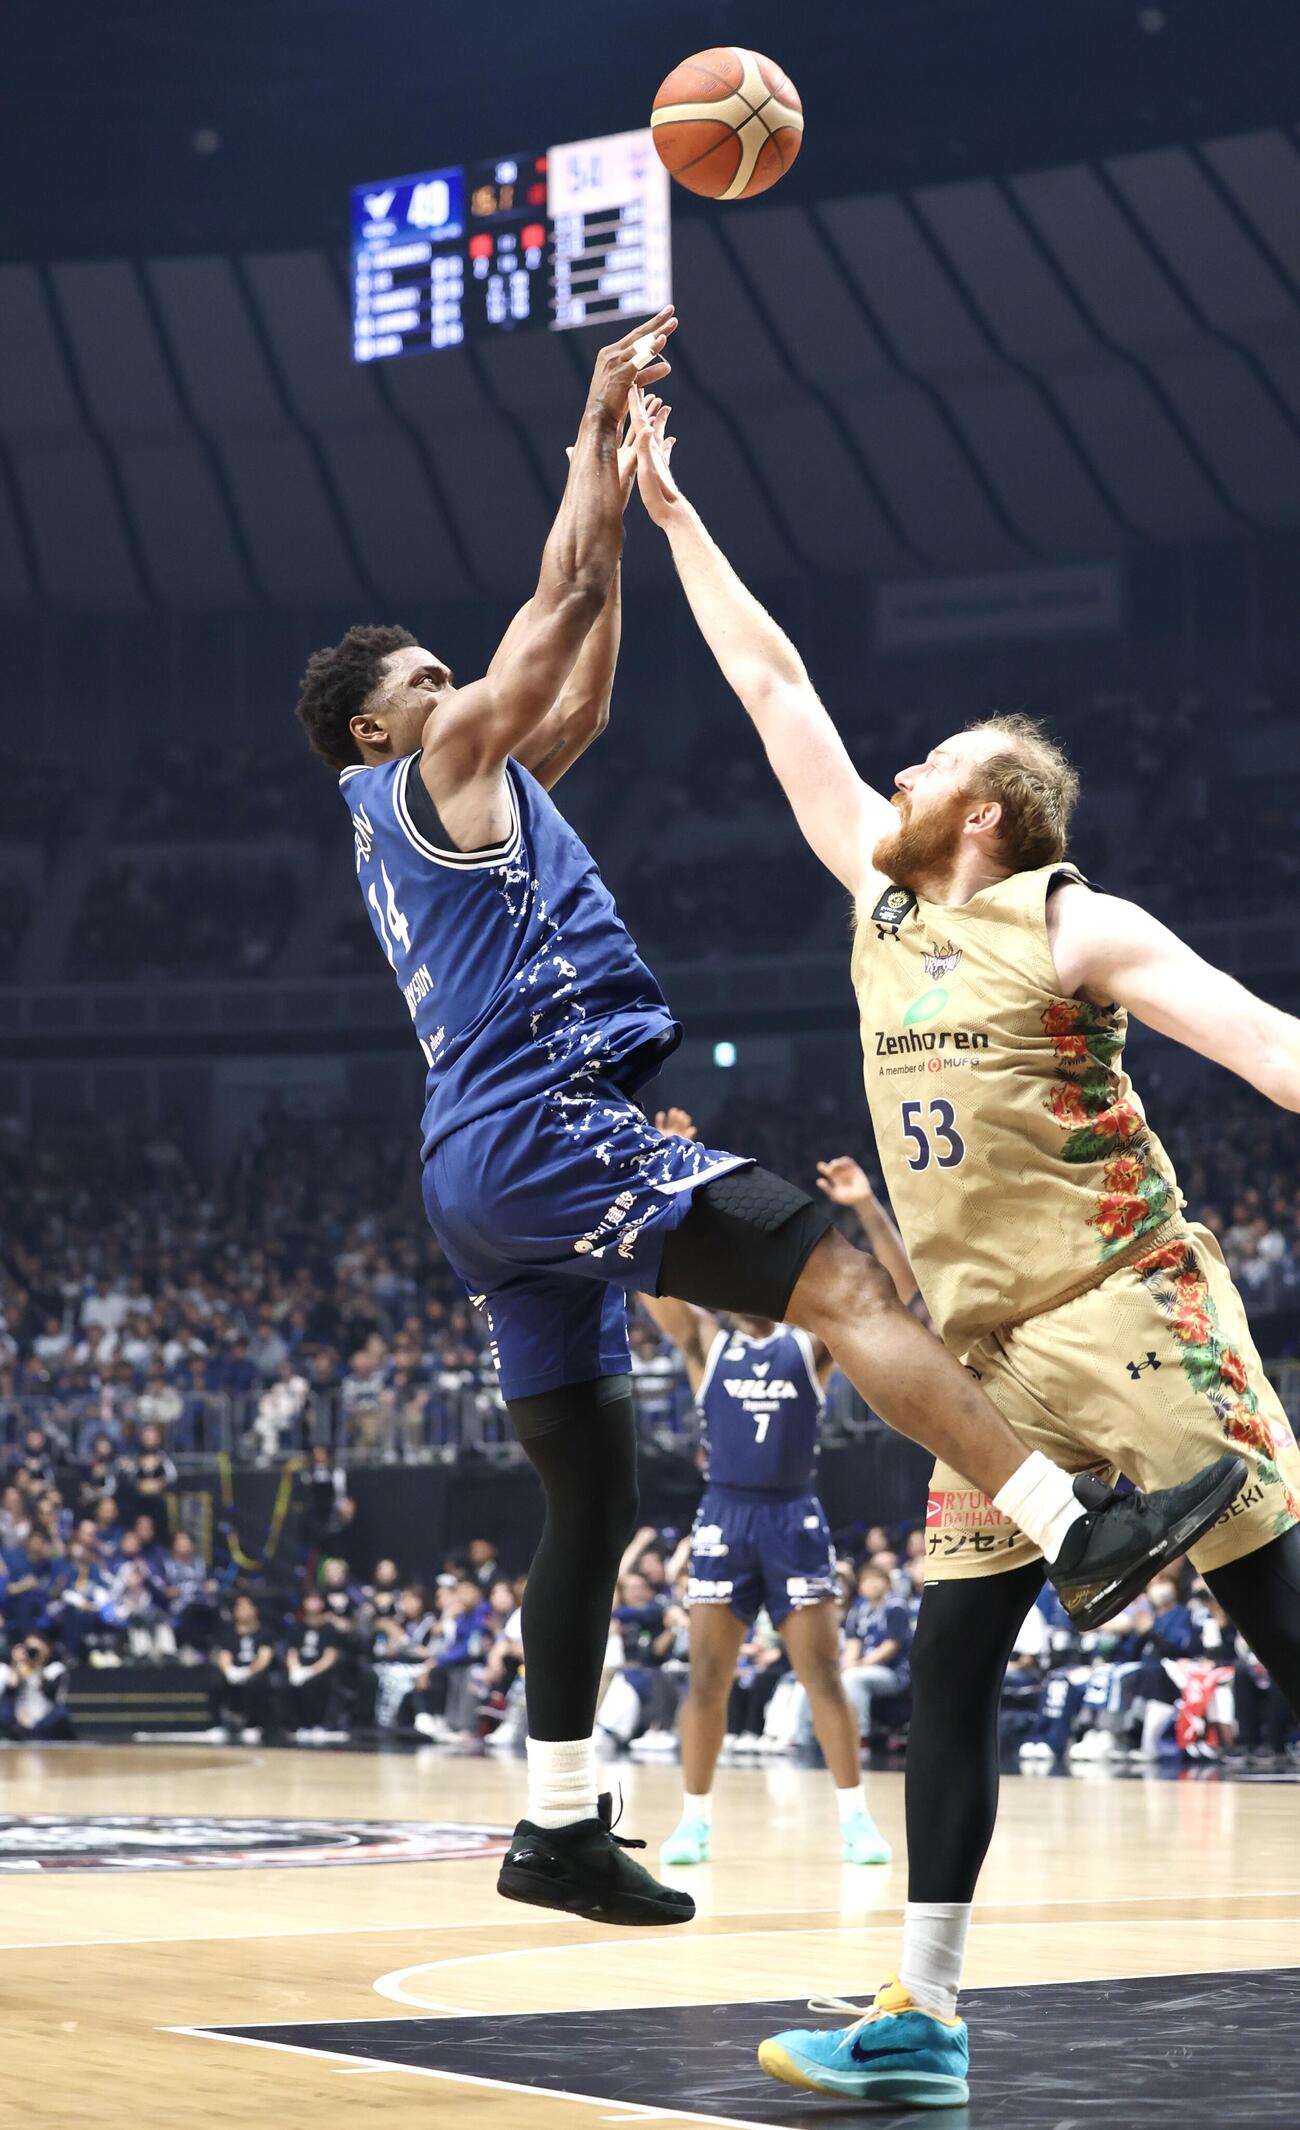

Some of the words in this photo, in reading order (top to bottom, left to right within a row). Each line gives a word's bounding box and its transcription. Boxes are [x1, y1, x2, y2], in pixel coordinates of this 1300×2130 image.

[368, 859, 412, 976] 14
[875, 1028, 989, 1056] Zenhoren
[879, 1066, 885, 1076] A
[885, 1064, 917, 1075] member
[917, 1061, 926, 1072] of
[943, 1057, 980, 1069] MUFG
[900, 1097, 967, 1173] 53
[752, 1412, 771, 1444] 7
[1211, 1484, 1265, 1529] SEKI
[928, 1530, 1022, 1556] ナンセイ
